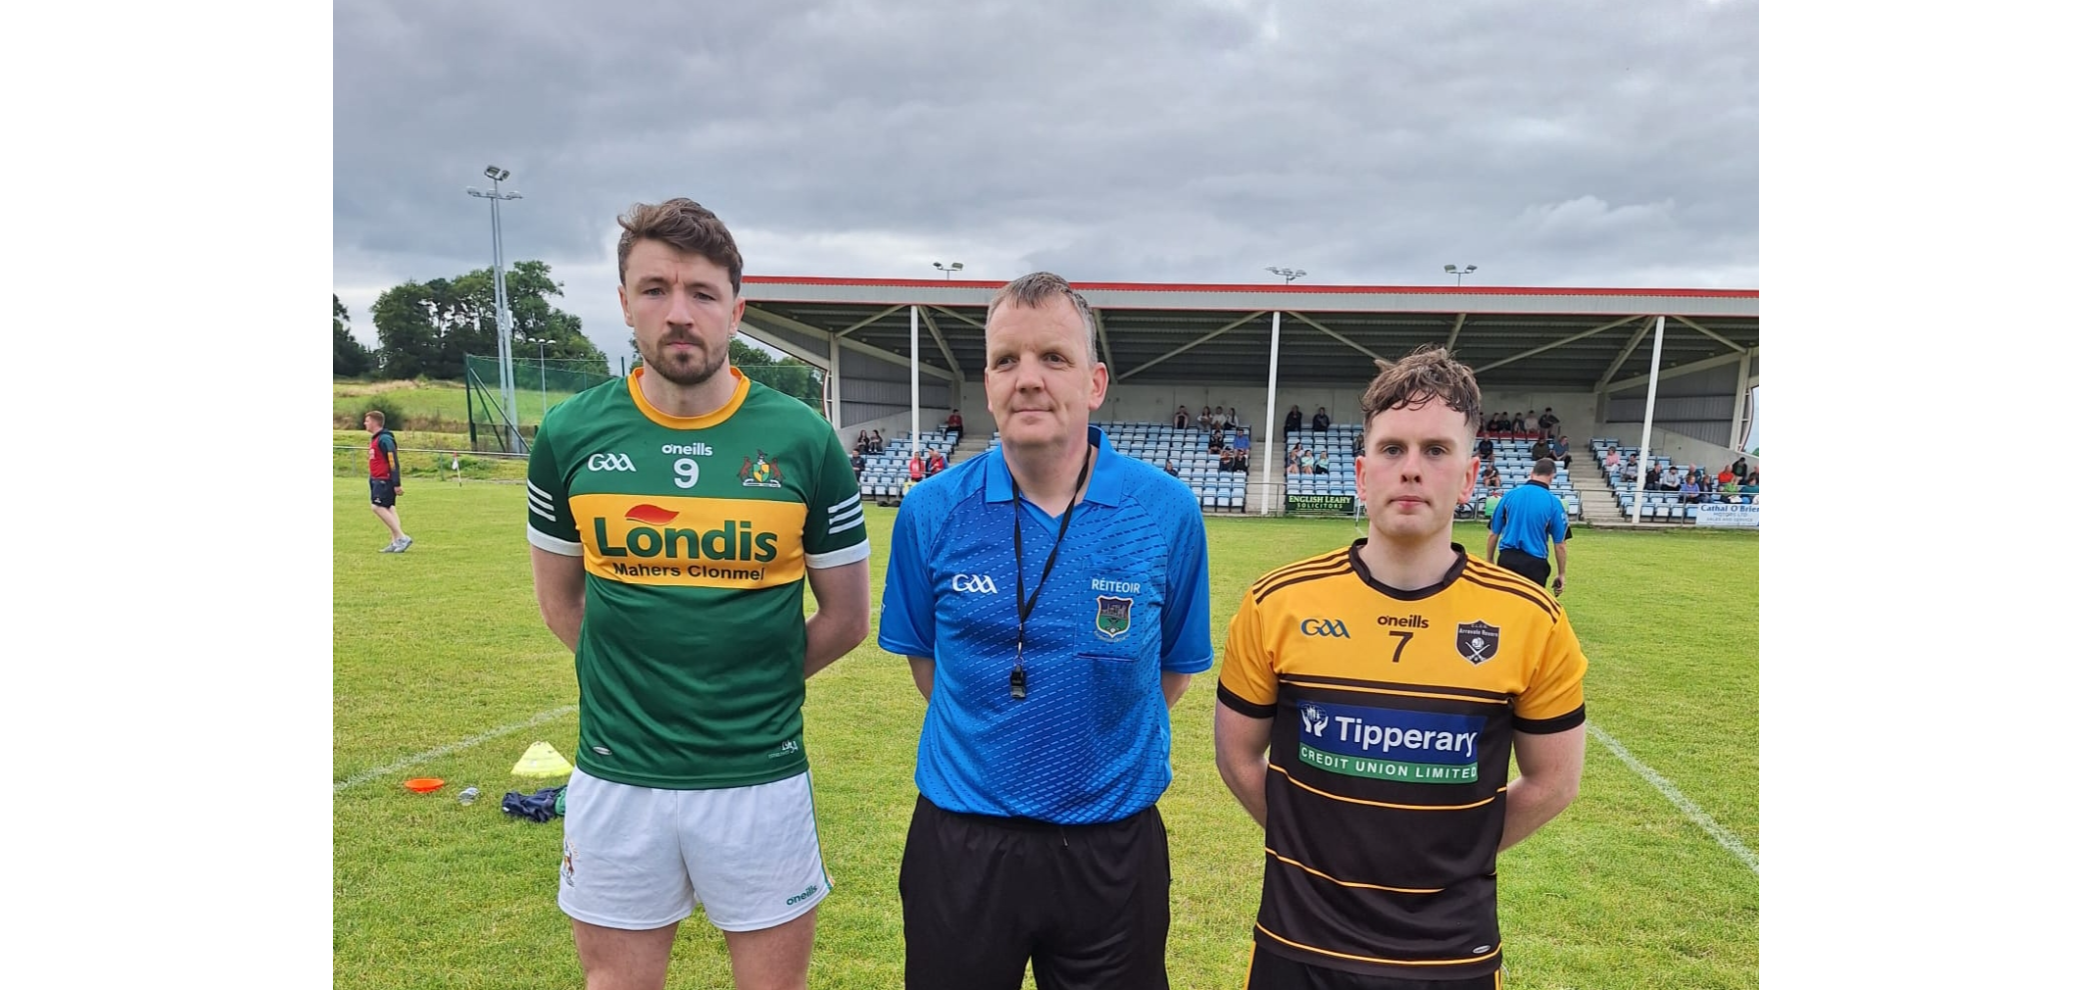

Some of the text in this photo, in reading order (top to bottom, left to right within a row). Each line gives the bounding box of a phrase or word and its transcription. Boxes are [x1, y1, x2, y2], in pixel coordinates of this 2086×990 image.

[587, 453, 636, 472] GAA
[674, 458, 699, 489] 9
[1289, 495, 1351, 504] ENGLISH LEAHY
[1701, 504, 1728, 512] Cathal
[594, 517, 778, 563] Londis
[613, 562, 765, 581] Mahers Clonmel
[952, 573, 998, 594] GAA
[1091, 577, 1141, 594] RÉITEOIR
[1301, 618, 1351, 639] GAA
[1388, 630, 1414, 663] 7
[1335, 716, 1477, 757] Tipperary
[1301, 747, 1477, 780] CREDIT UNION LIMITED
